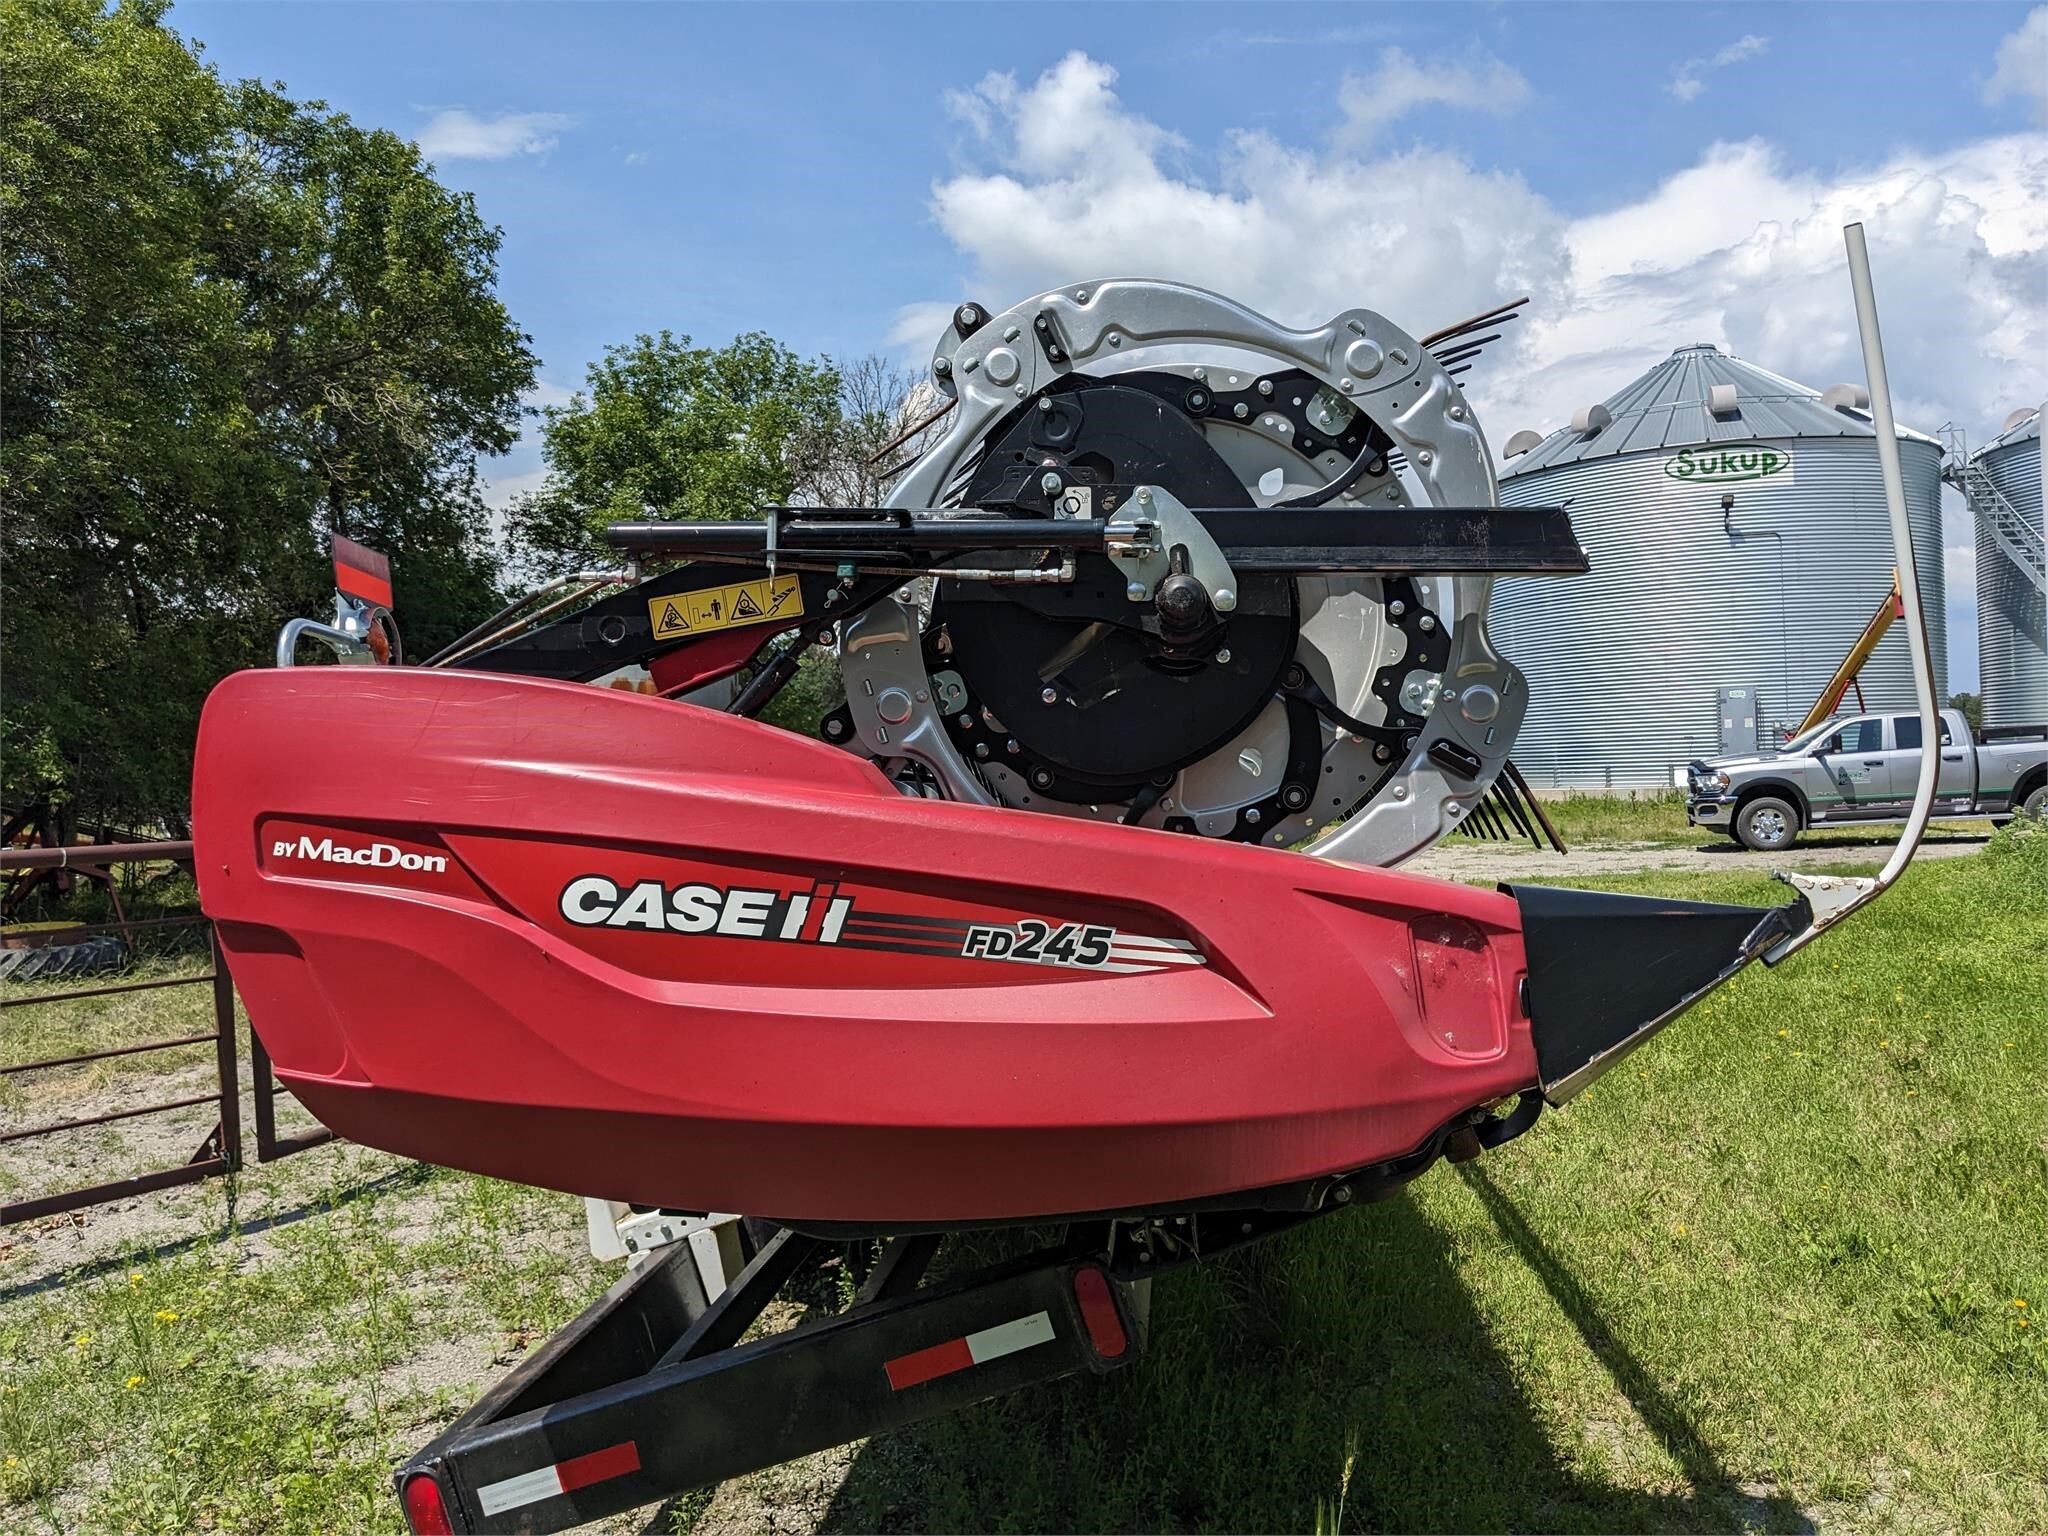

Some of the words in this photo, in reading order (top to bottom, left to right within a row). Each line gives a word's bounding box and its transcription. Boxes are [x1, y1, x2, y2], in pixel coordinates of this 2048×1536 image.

[1676, 449, 1778, 477] Sukup
[272, 840, 297, 858] BY
[298, 836, 447, 874] MacDon
[560, 877, 776, 937] CASE
[961, 919, 1116, 967] FD245
